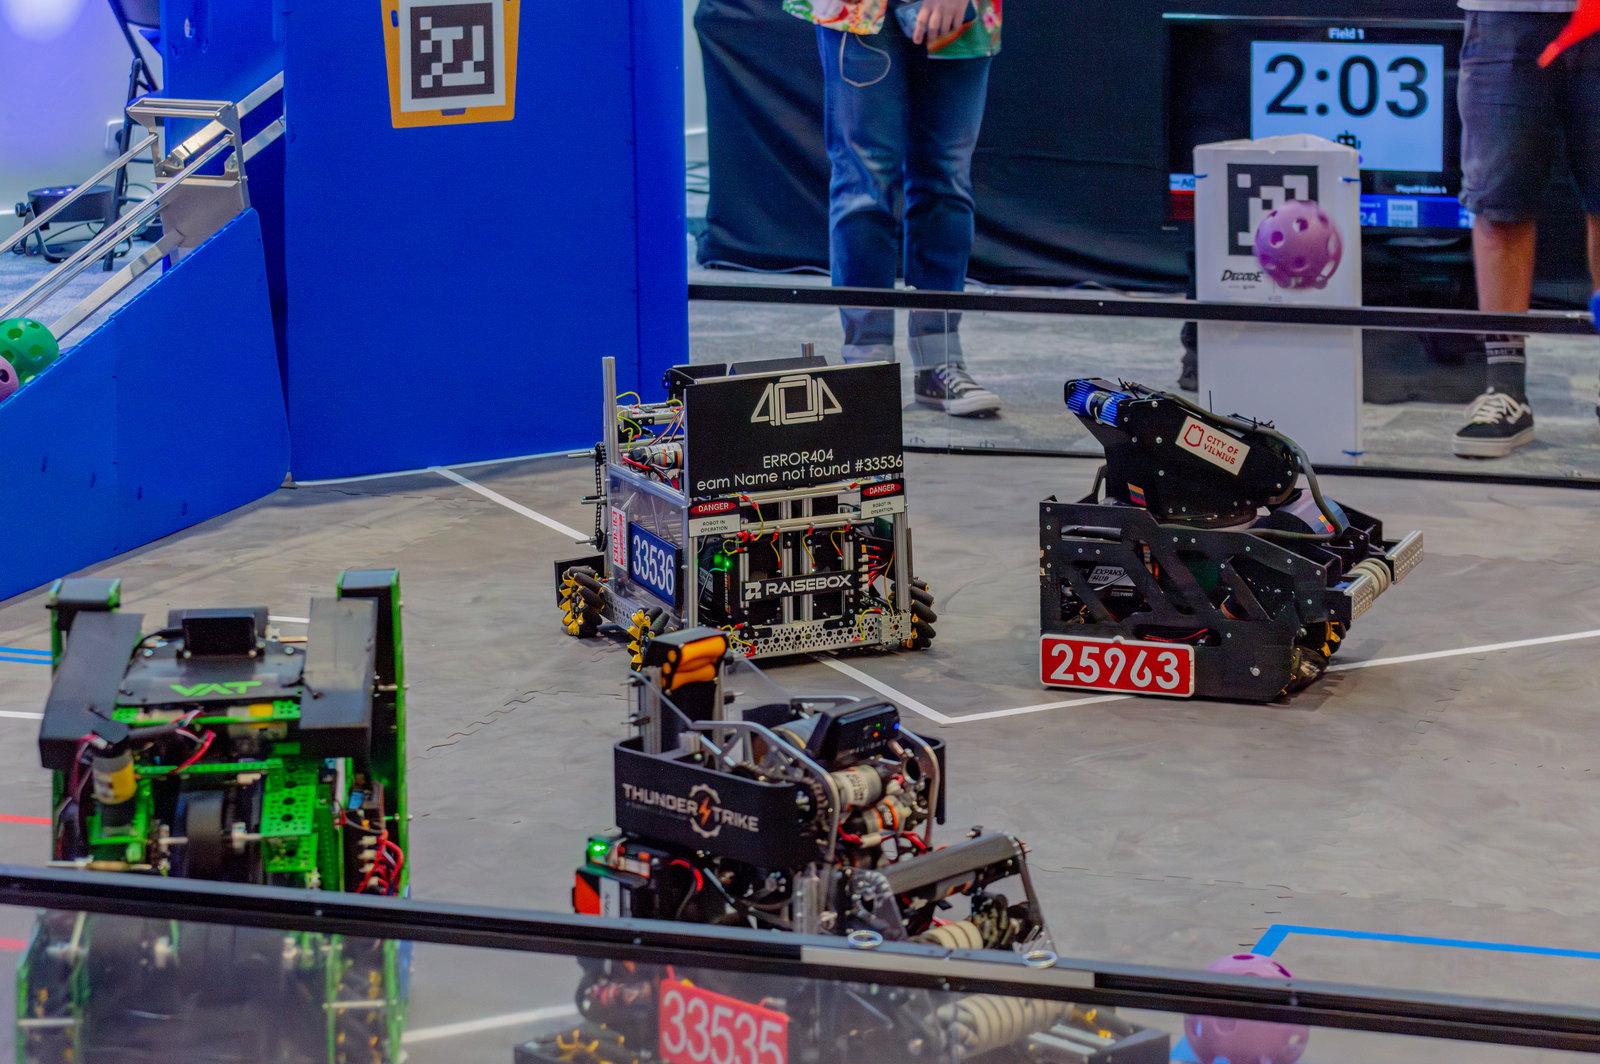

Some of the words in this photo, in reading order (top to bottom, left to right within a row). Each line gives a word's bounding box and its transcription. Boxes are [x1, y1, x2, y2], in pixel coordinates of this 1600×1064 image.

[1328, 27, 1356, 40] Field
[1357, 28, 1365, 40] 1
[1265, 53, 1429, 119] 2:03
[1203, 443, 1236, 465] VILNIUS
[1206, 435, 1227, 448] CITY
[1227, 445, 1239, 456] OF
[763, 448, 834, 469] ERROR404
[734, 472, 778, 487] Name
[782, 466, 806, 481] not
[809, 460, 851, 478] found
[855, 454, 904, 472] #33536
[869, 483, 896, 495] DANGER
[698, 502, 729, 513] DANGER
[870, 507, 894, 515] OPERATION
[632, 534, 674, 596] 33536
[1094, 568, 1124, 577] EXPANS
[765, 573, 852, 596] RAISEBOX
[1050, 643, 1181, 690] 25963
[170, 681, 263, 697] VAT
[622, 782, 699, 817] THUNDER
[663, 989, 785, 1064] 33535
